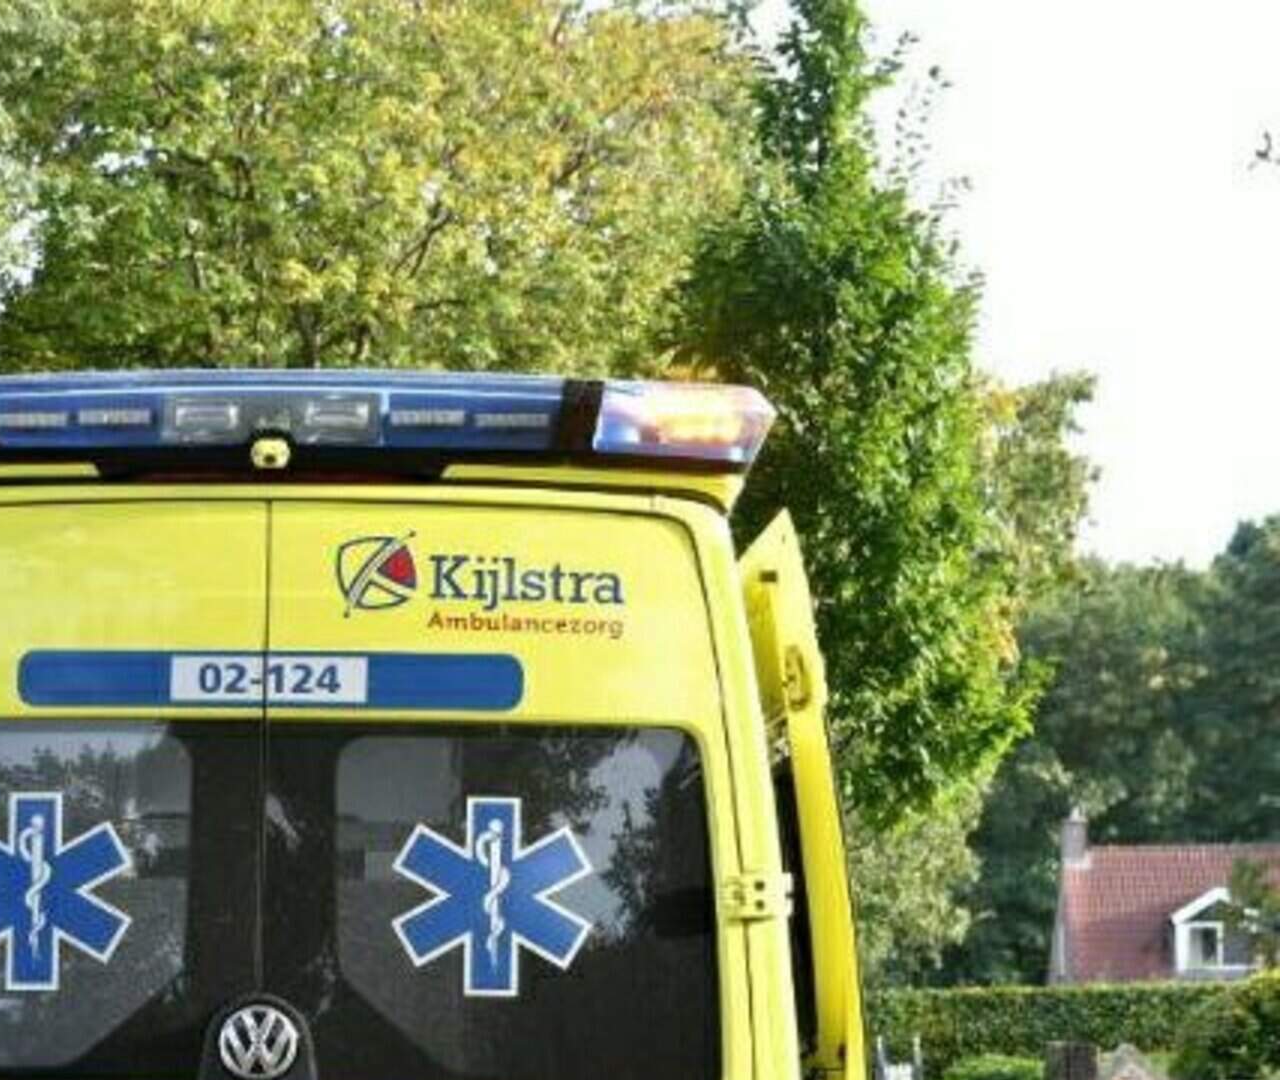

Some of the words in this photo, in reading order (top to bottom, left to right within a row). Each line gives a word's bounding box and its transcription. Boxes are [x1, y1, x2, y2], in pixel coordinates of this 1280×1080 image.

[427, 555, 624, 609] Kijlstra
[427, 611, 624, 638] Ambulancezorg
[198, 662, 341, 695] 02-124
